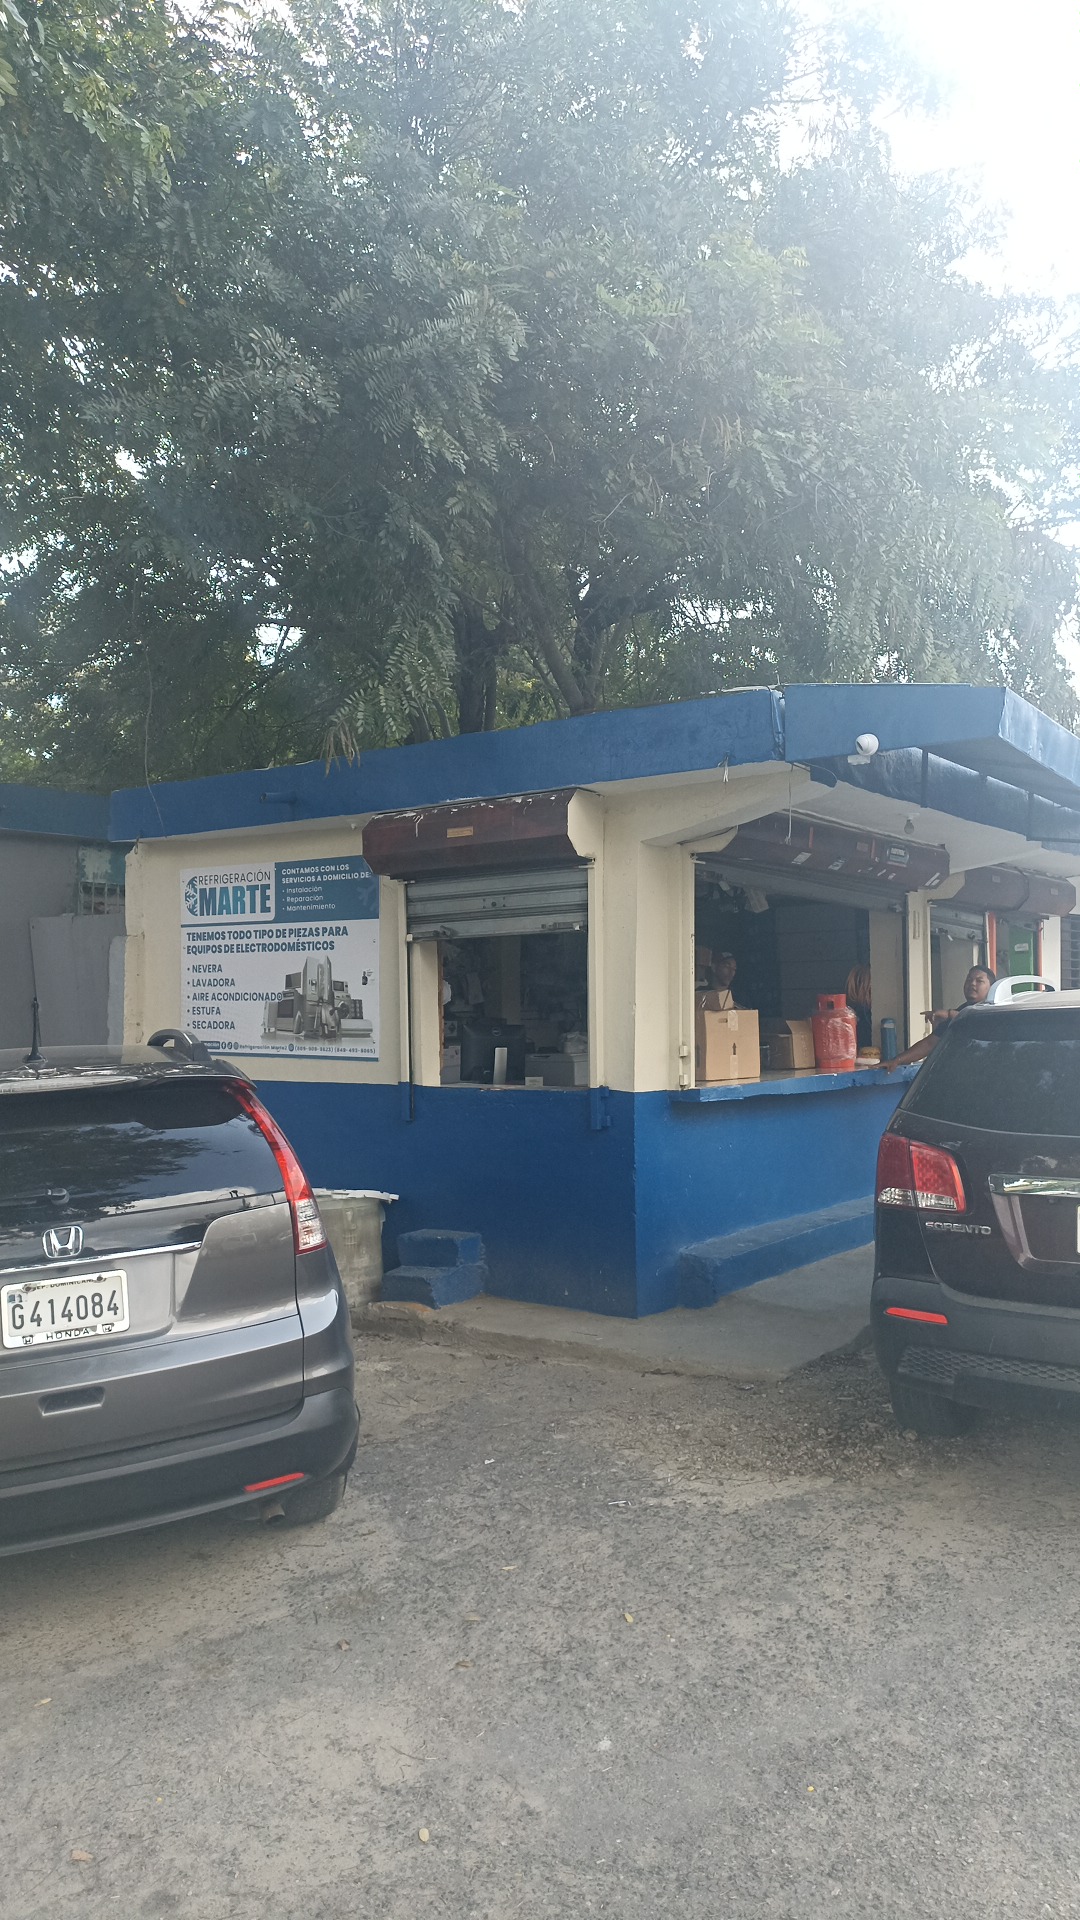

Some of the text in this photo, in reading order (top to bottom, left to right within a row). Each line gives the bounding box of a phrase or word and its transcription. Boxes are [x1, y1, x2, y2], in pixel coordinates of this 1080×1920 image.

[281, 863, 350, 876] CONTAMOS CON LOS
[198, 869, 271, 886] REFRIGERACIÓN
[281, 875, 316, 884] SERVICIOS
[322, 872, 359, 882] DOMICILIO
[286, 885, 323, 894] Instalación
[199, 883, 271, 916] MARTE
[286, 894, 323, 904] Reparación
[286, 903, 336, 912] Mantenimiento
[186, 926, 349, 942] TENEMOS TODO TIPO DE PIEZAS PARA
[186, 939, 335, 955] EQUIPOS DE ELECTRODOMÉSTICOS
[192, 964, 223, 974] NEVERA
[192, 978, 236, 987] LAVADORA
[192, 992, 283, 1002] AIRE ACONDICIONADO
[192, 1006, 221, 1016] ESTUFA
[192, 1020, 236, 1030] SECADORA
[925, 1221, 992, 1235] SORENTO
[12, 1290, 119, 1330] G414084
[46, 1328, 90, 1341] HONDA
